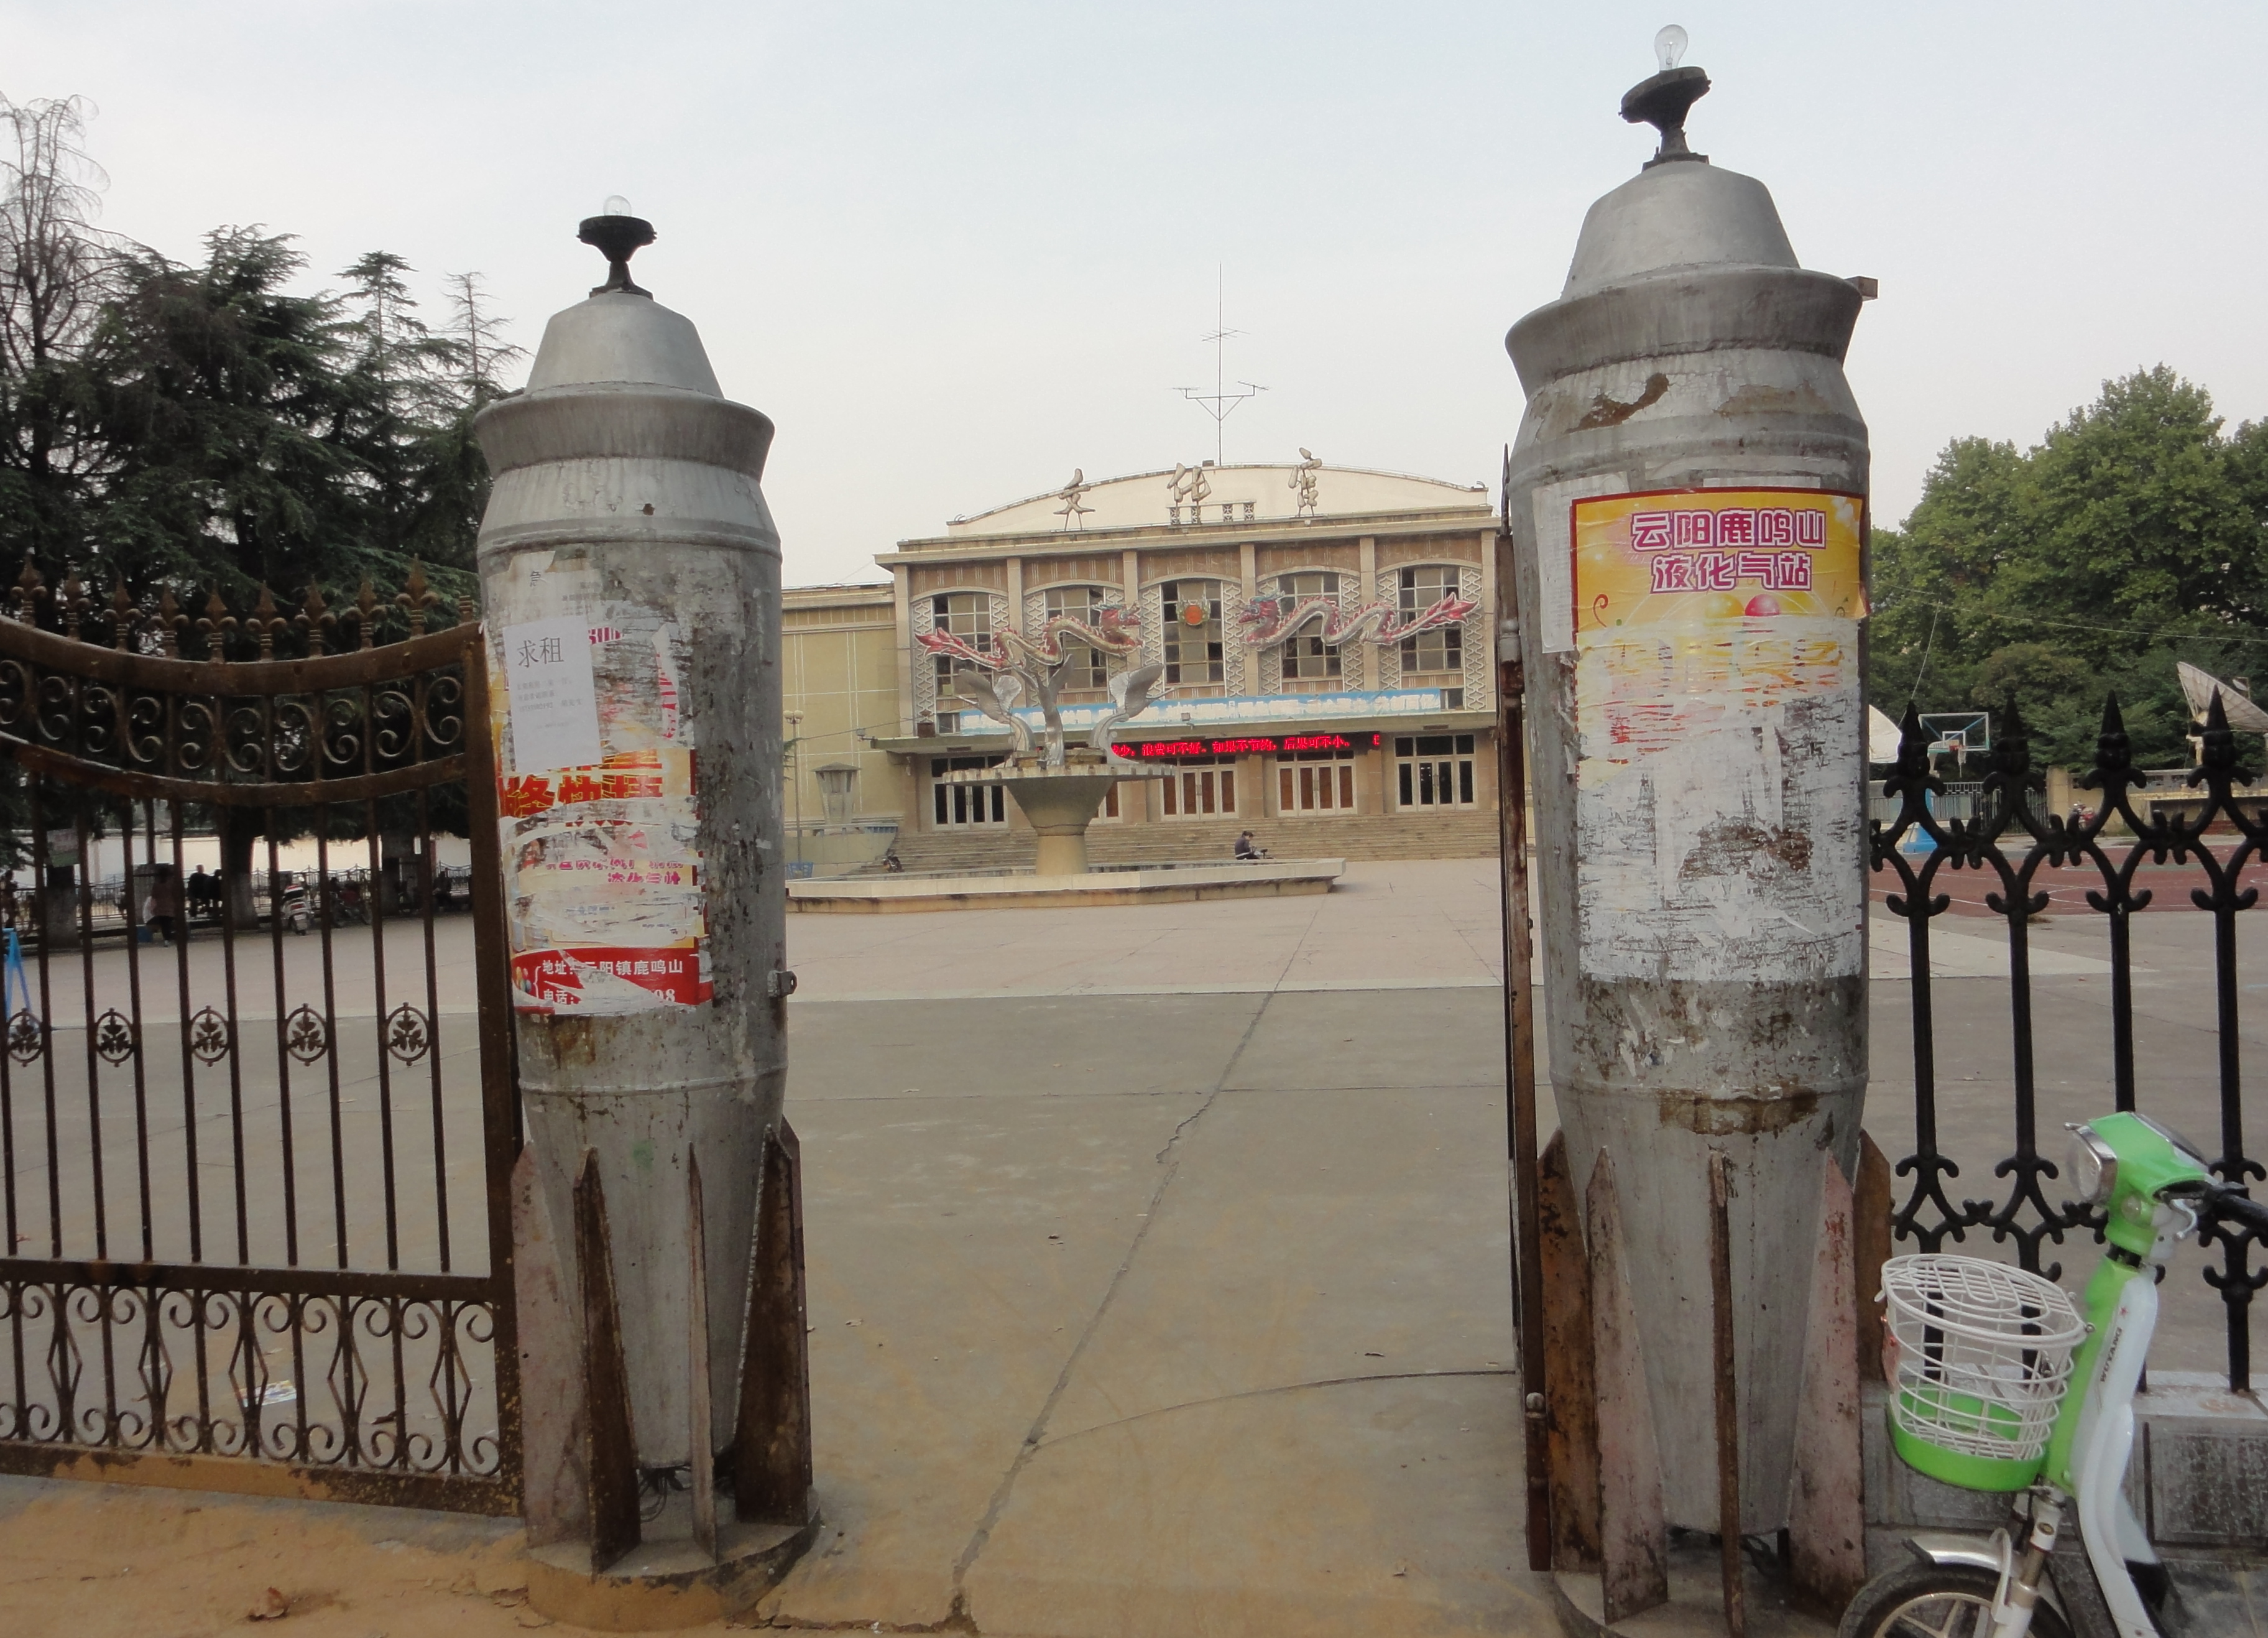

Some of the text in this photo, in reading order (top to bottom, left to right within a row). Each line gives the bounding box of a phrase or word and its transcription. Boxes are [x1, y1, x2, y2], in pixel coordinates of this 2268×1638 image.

[1631, 508, 1826, 552] 云阳鹿鸣山
[1651, 550, 1812, 593] 液化气站
[517, 637, 564, 668] 求租
